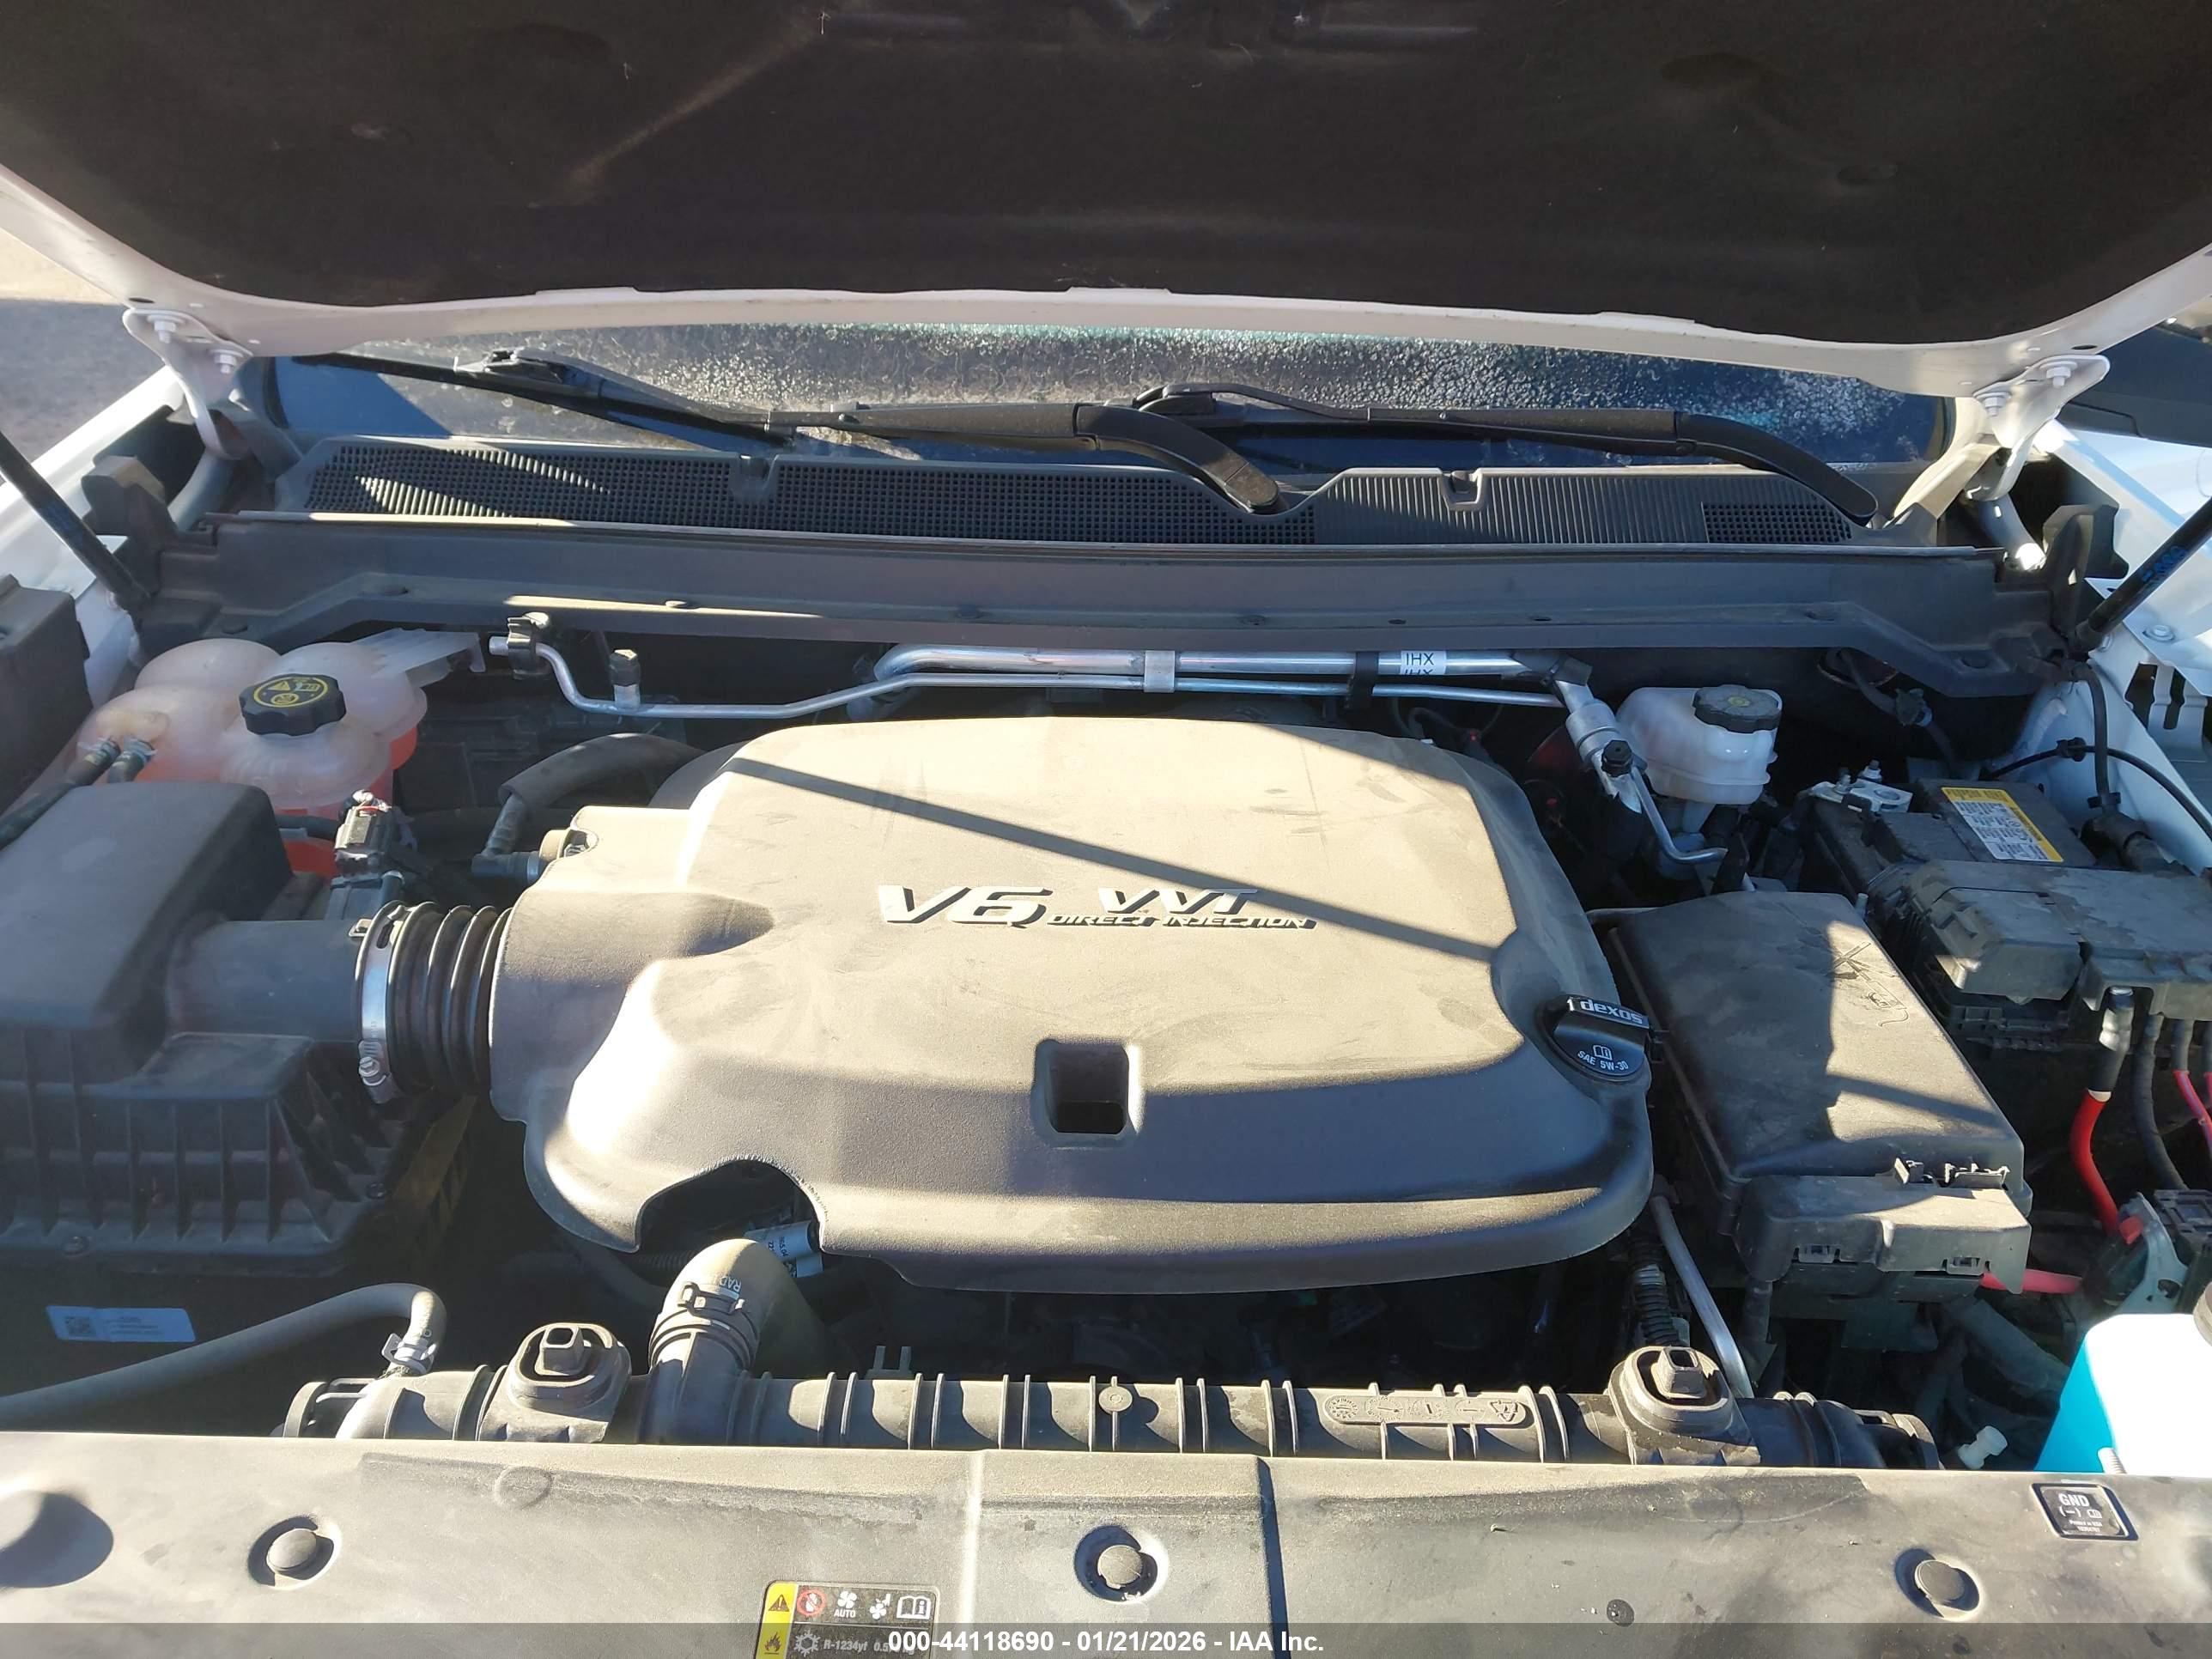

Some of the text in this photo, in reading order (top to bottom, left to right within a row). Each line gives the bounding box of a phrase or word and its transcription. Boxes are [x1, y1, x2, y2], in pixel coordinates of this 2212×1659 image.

[1406, 653, 1434, 665] IHX
[878, 885, 1257, 927] V6 VVT
[1047, 914, 1318, 930] DIRECT INJECTION
[1580, 999, 1643, 1024] dexos
[1577, 1050, 1629, 1071] SAE 5W-30
[2058, 1493, 2090, 1507] GND
[834, 1608, 856, 1619] AUTO
[823, 1638, 868, 1654] R-1234yf
